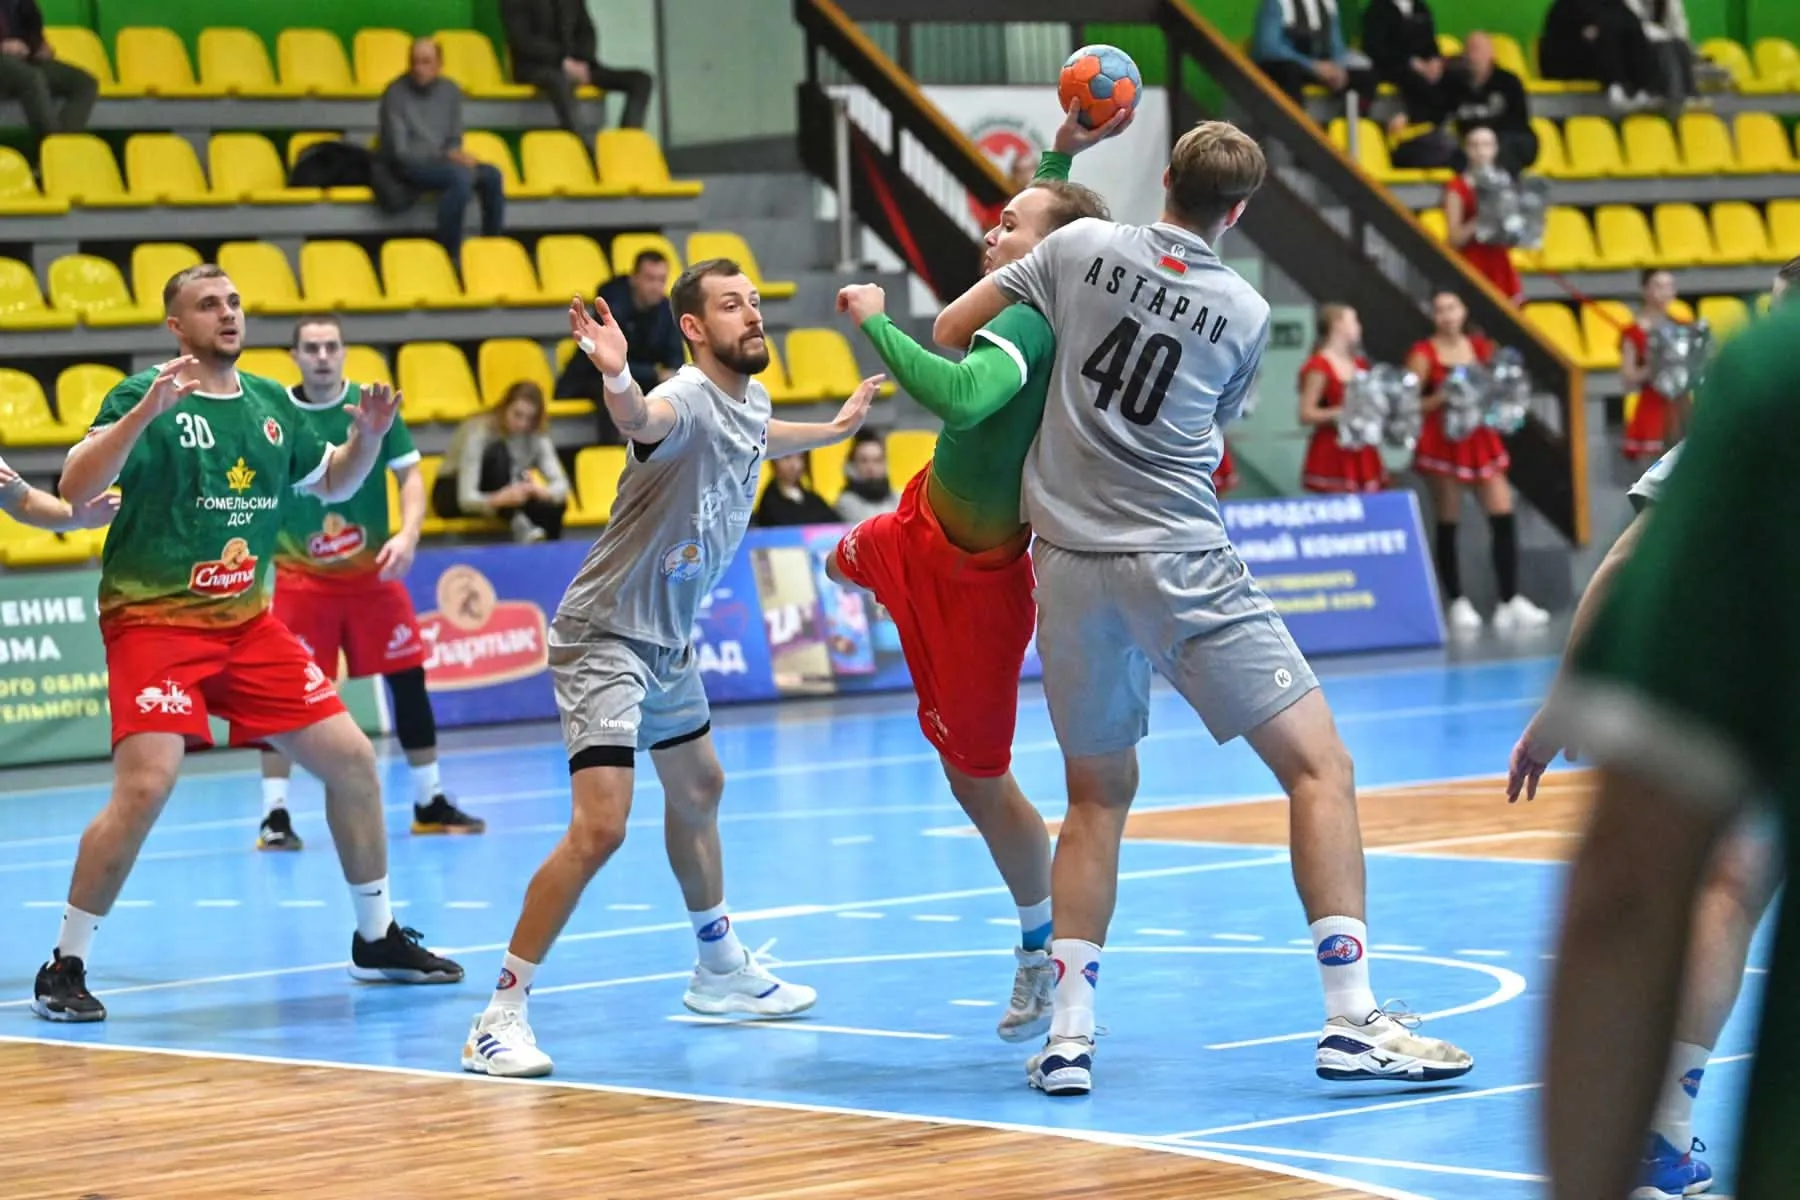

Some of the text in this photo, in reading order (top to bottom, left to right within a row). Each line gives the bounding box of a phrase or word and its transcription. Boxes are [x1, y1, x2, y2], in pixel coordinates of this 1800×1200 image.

[1084, 257, 1228, 344] ASTAPAU
[1081, 316, 1183, 426] 40
[176, 412, 215, 449] 30
[1224, 494, 1364, 528] ГОРОДСКОЙ
[1300, 529, 1407, 559] КОМИТЕТ
